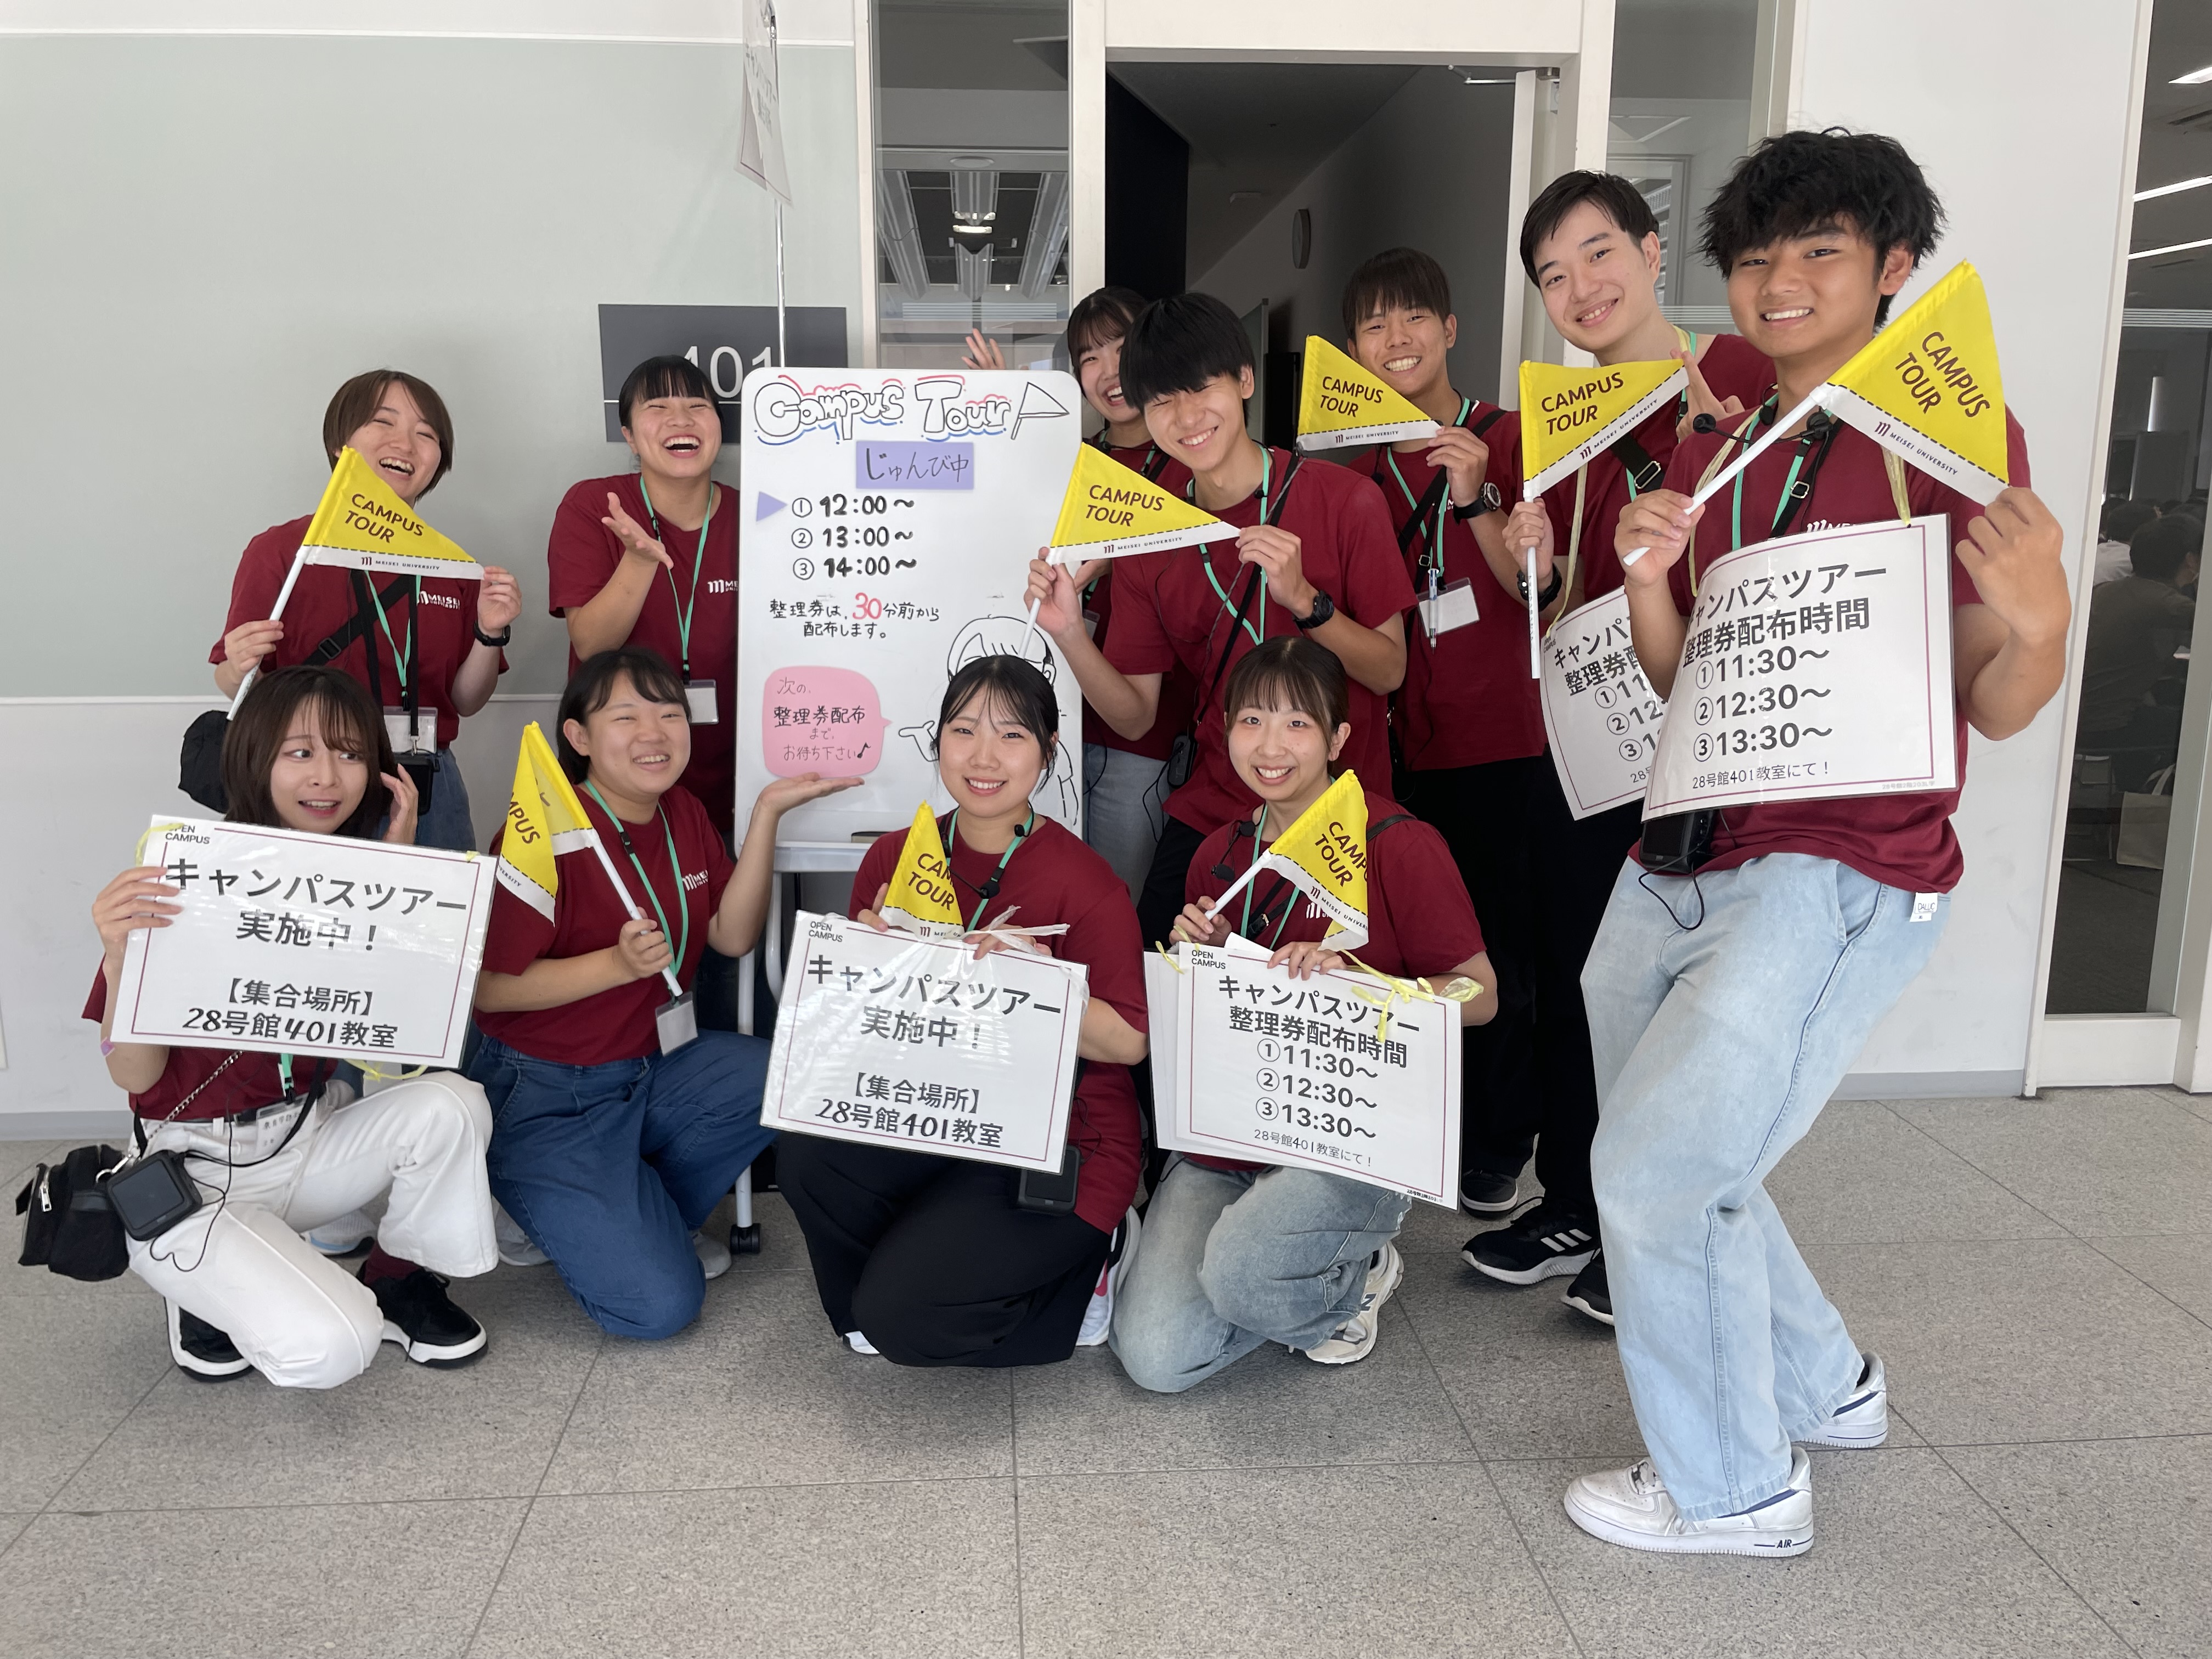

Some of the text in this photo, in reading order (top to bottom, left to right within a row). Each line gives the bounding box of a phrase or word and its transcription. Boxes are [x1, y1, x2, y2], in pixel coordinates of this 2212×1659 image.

[1322, 376, 1384, 403] CAMPUS
[1542, 372, 1624, 413] CAMPUS
[1895, 352, 1941, 414] TOUR
[1922, 331, 1990, 417] CAMPUS
[754, 381, 1011, 439] Campus Tour
[1319, 395, 1359, 417] TOUR
[1547, 404, 1598, 435] TOUR
[1594, 430, 1617, 448] MEISEI
[1620, 399, 1658, 430] UNIVERSITY
[866, 448, 969, 482] じゅんび中
[1890, 432, 1914, 449] MEISEI
[1917, 448, 1958, 475] UNIVERSITY
[352, 493, 424, 537] CAMPUS
[1086, 504, 1134, 527] TOUR
[1089, 484, 1165, 511] CAMPUS
[345, 510, 394, 543] TOUR
[1144, 537, 1182, 547] UNIVERSITY
[803, 622, 887, 639] 配布します。
[1555, 616, 1630, 669] キャンパ
[1683, 597, 1870, 668] 整理券配布時間
[774, 706, 866, 727] 整理券配布
[165, 832, 211, 845] CAMPUS
[1329, 822, 1368, 882] CAMP
[499, 865, 522, 887] VERSITY
[918, 853, 953, 887] CAM
[1314, 834, 1353, 887] TOUR
[165, 858, 467, 915] キャンパスツアー
[907, 871, 955, 911] TOUR
[1321, 896, 1341, 915] MEISEI
[236, 910, 376, 951] 実施中！
[809, 930, 843, 943] CAMPUS
[810, 921, 832, 932] OPEN
[1191, 958, 1226, 970] CAMPUS
[1192, 950, 1214, 959] OPEN
[228, 978, 374, 1016] 【集合場所】
[808, 955, 1062, 1014] キャンパスツアー
[1218, 975, 1420, 1032] キャンパスツアー
[183, 1007, 398, 1048] 28号館401教室
[860, 1005, 981, 1048] 実施中！
[1229, 1005, 1407, 1068] 整理券配布時間
[855, 1071, 980, 1114] 【集合場所】
[815, 1099, 1003, 1148] 28号館401教室
[1776, 1539, 1792, 1549] AIR
